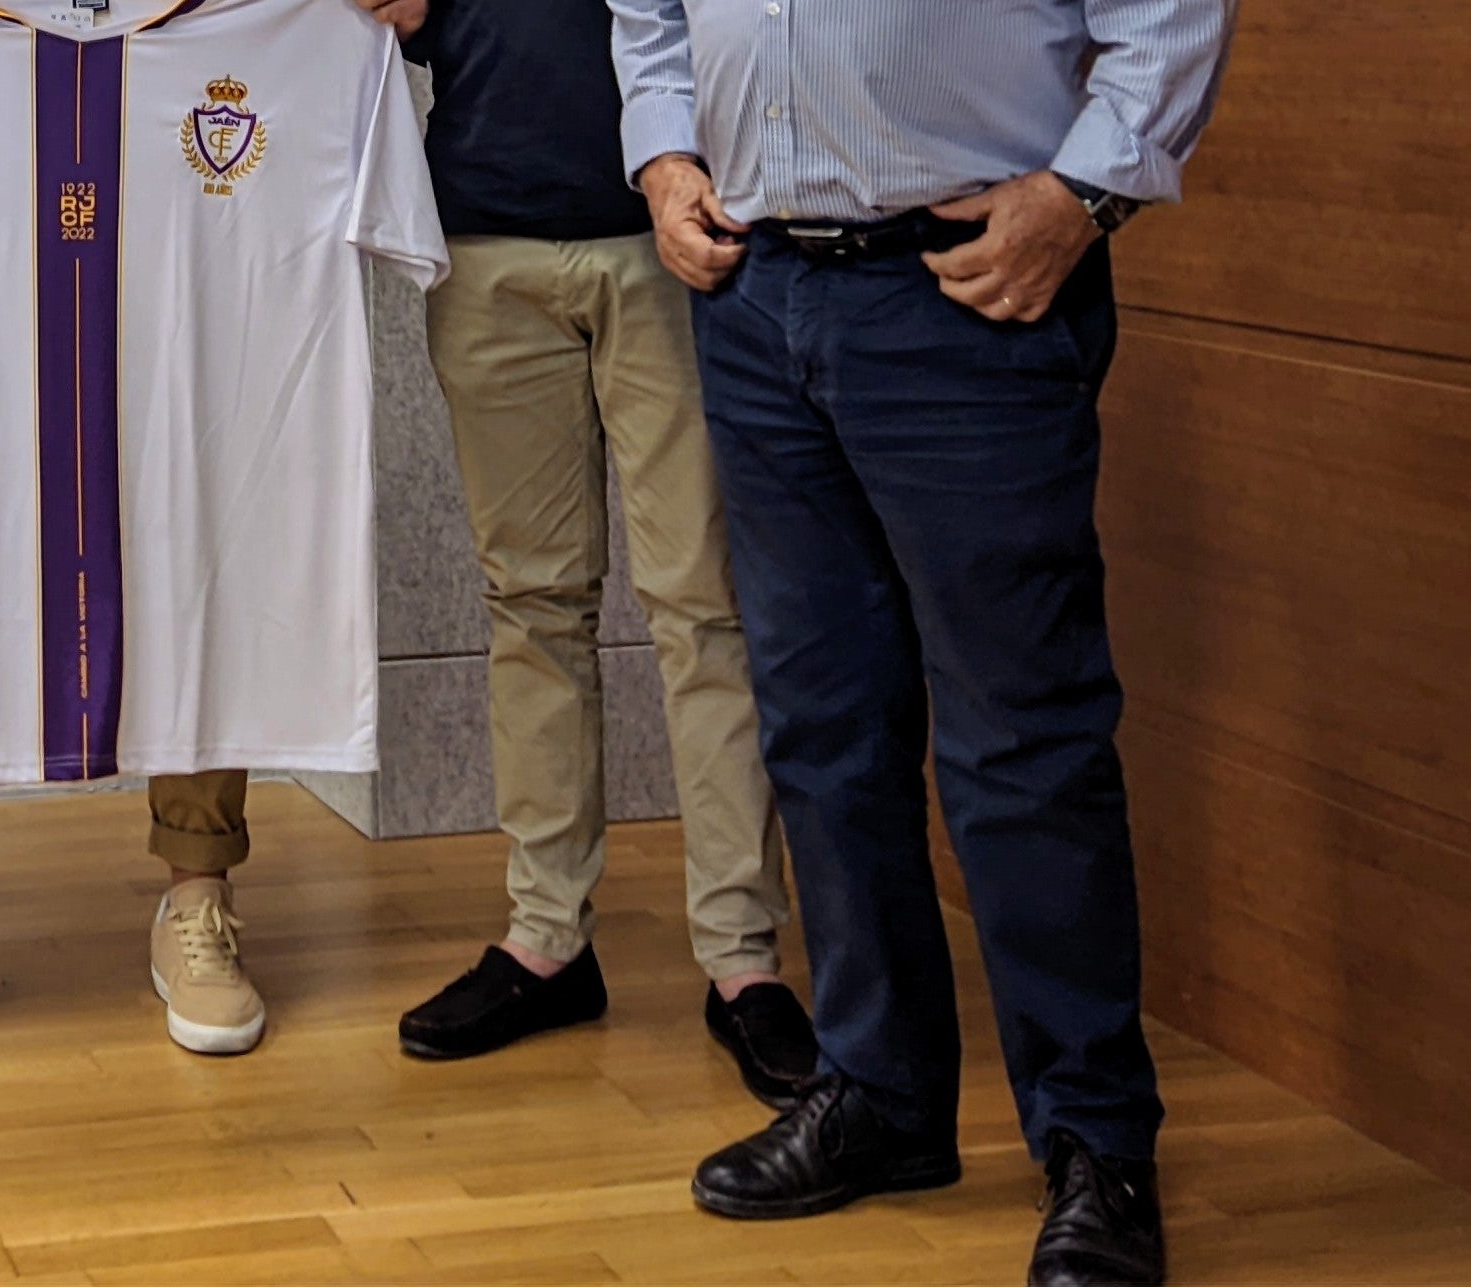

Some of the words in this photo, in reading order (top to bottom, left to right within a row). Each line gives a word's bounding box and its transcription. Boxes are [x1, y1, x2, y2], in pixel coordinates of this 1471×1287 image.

[208, 116, 241, 128] JAÉN
[60, 182, 96, 195] 1922
[60, 226, 96, 240] 2022
